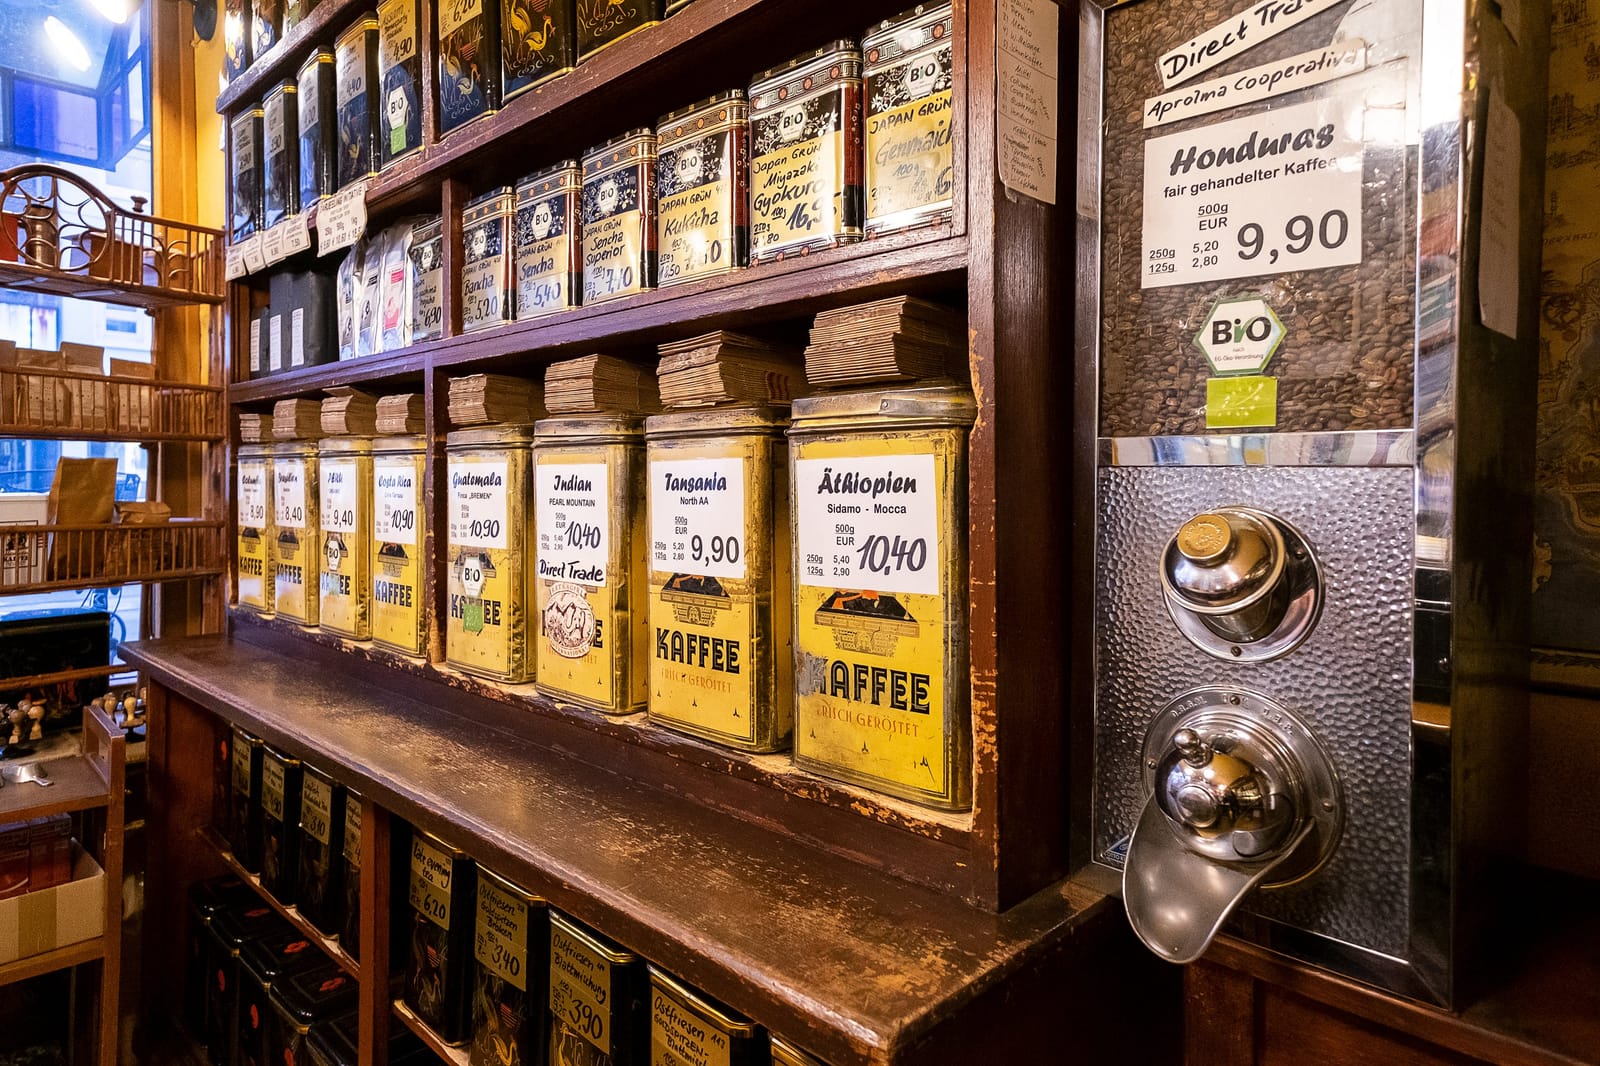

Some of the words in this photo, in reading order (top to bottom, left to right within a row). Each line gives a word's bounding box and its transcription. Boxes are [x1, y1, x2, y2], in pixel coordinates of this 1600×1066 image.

[1163, 20, 1248, 79] Direct
[1254, 0, 1314, 26] Tra
[911, 63, 936, 82] BiO
[783, 112, 803, 128] BiO
[870, 109, 914, 134] JAPAN
[918, 97, 952, 116] GRÜN
[1170, 123, 1335, 176] Honduras
[681, 157, 697, 171] BiO
[753, 157, 787, 174] Japan
[1164, 186, 1187, 199] fair
[1191, 168, 1280, 195] gehandelter
[1284, 157, 1337, 176] Kaffee
[600, 188, 614, 201] BiO
[660, 198, 688, 214] JAPAN
[690, 190, 712, 205] GRÜN
[754, 179, 825, 217] Gyokuro
[535, 213, 549, 225] BiO
[1198, 203, 1229, 216] 500g
[664, 207, 719, 239] Kukicha
[1199, 217, 1228, 231] EUR
[591, 231, 624, 251] Sencha
[1237, 209, 1349, 264] 9,90
[586, 244, 625, 267] Superior
[1149, 248, 1175, 260] 250g
[1192, 240, 1219, 254] 5,20
[520, 256, 554, 281] Sencha
[1149, 263, 1175, 275] 125g
[1192, 255, 1218, 268] 2,80
[464, 272, 494, 296] Bancha
[534, 282, 561, 308] 5,40
[475, 296, 498, 320] 5,20
[1212, 316, 1272, 345] BiO
[452, 472, 502, 488] Guatemala
[553, 474, 592, 492] Indian
[664, 472, 727, 493] Tansania
[817, 467, 917, 499] Äthiopien
[549, 498, 565, 506] PEARL
[566, 498, 596, 507] MOUNTAIN
[680, 497, 698, 506] North
[699, 497, 709, 505] AA
[827, 503, 861, 514] Sidamo
[873, 503, 907, 514] Mocca
[285, 506, 303, 523] 8,40
[334, 509, 353, 528] 9,40
[391, 509, 414, 531] 10,90
[674, 516, 688, 526] 500g
[469, 519, 500, 539] 10,90
[564, 521, 601, 550] 10,40
[675, 526, 688, 535] EUR
[835, 524, 855, 534] 500g
[673, 542, 685, 551] 5,20
[691, 534, 740, 567] 9,90
[836, 536, 855, 546] EUR
[240, 555, 263, 576] KAFFEE
[807, 553, 823, 563] 250g
[833, 555, 850, 564] 5,40
[856, 534, 927, 576] 10,40
[277, 563, 302, 584] KAFFEE
[465, 568, 480, 582] BiO
[539, 559, 566, 578] Direct
[567, 560, 604, 582] Trade
[807, 566, 823, 575] 125g
[833, 567, 850, 576] 2,90
[375, 580, 413, 608] KAFFEE
[656, 627, 740, 675] KAFFEE
[857, 713, 919, 737] GERÖSTET
[422, 866, 434, 883] tea
[424, 893, 446, 920] 6,20
[491, 944, 520, 976] 3,40
[553, 934, 594, 971] Ostfriesen
[554, 952, 607, 1005] Blattmischung
[569, 1000, 603, 1039] 3,90
[654, 996, 705, 1042] Ostfriesen
